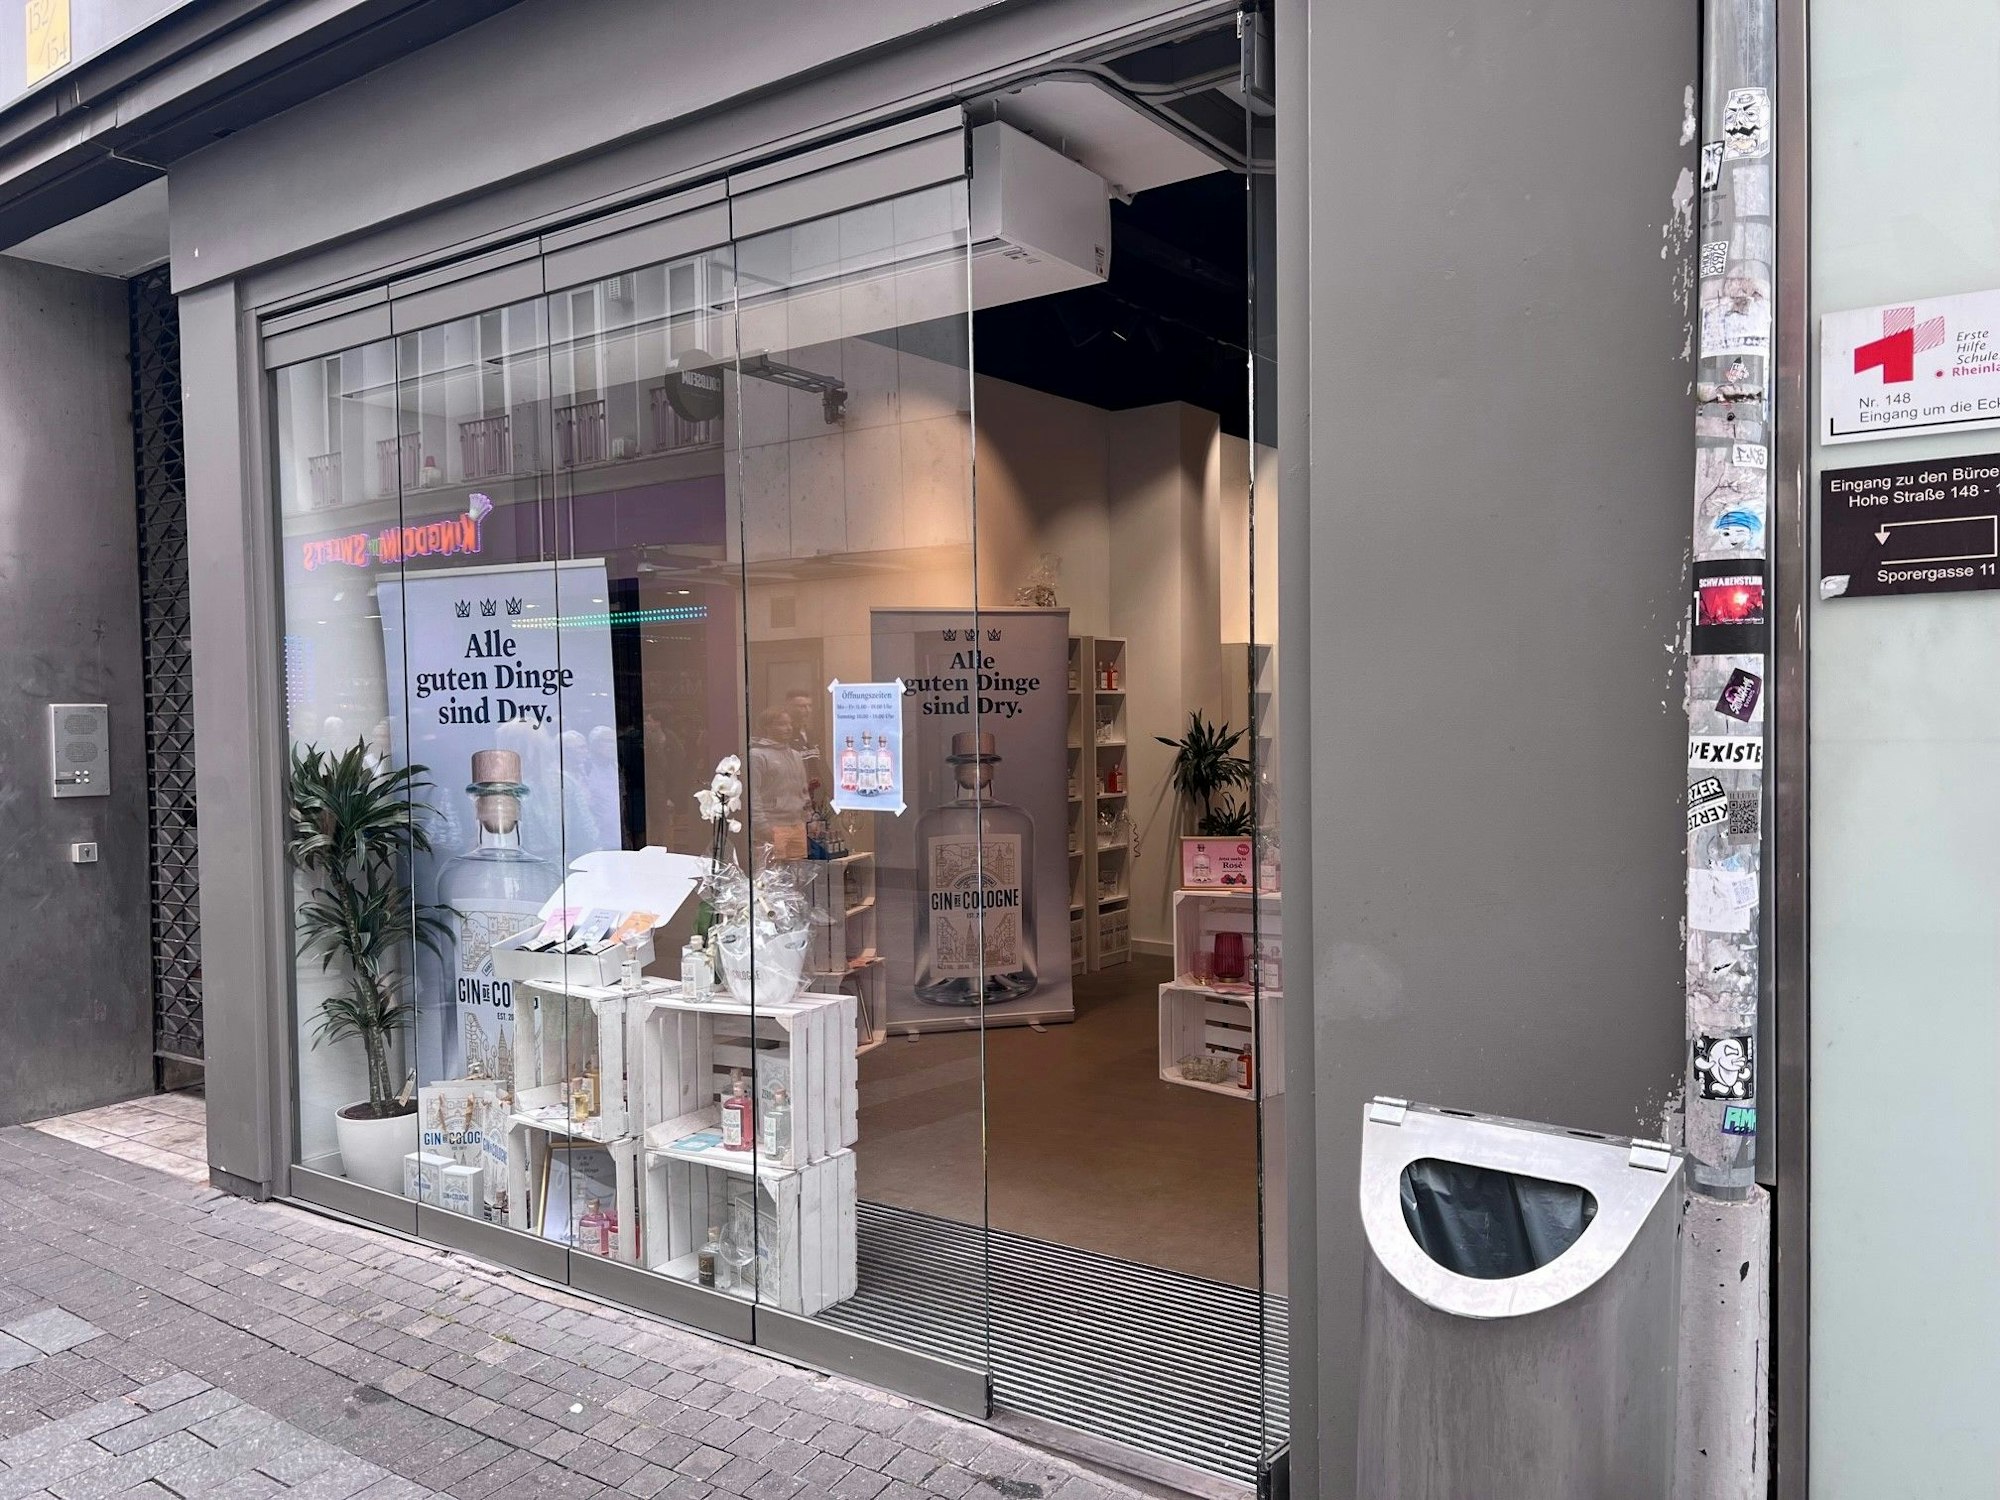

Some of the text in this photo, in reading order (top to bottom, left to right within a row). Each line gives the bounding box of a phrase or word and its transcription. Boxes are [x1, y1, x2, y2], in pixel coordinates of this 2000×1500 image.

[1956, 330, 1989, 342] Erste
[1956, 341, 1987, 353] Hilfe
[1956, 351, 1999, 365] Schule
[1859, 392, 1911, 409] Nr. 148
[1859, 406, 1918, 424] Eingang
[1923, 405, 1945, 417] um
[1950, 401, 1972, 413] die
[1830, 467, 1999, 493] Eingang zu den Büroe
[1849, 494, 1889, 508] Hohe
[1893, 488, 1945, 505] Straße
[1950, 484, 1979, 499] 148
[1877, 563, 1996, 584] Sporergasse 11
[464, 629, 517, 658] Alle
[949, 650, 996, 670] Alle
[416, 660, 574, 698] guten Dinge
[903, 672, 1041, 697] guten Dinge
[438, 696, 553, 731] sind Dry.
[922, 696, 1023, 719] sind Dry.
[1222, 861, 1243, 869] Rosé
[931, 892, 952, 910] GIN
[963, 889, 1019, 909] COLOGNE
[458, 977, 481, 1005] GIN
[424, 1132, 441, 1145] GIN
